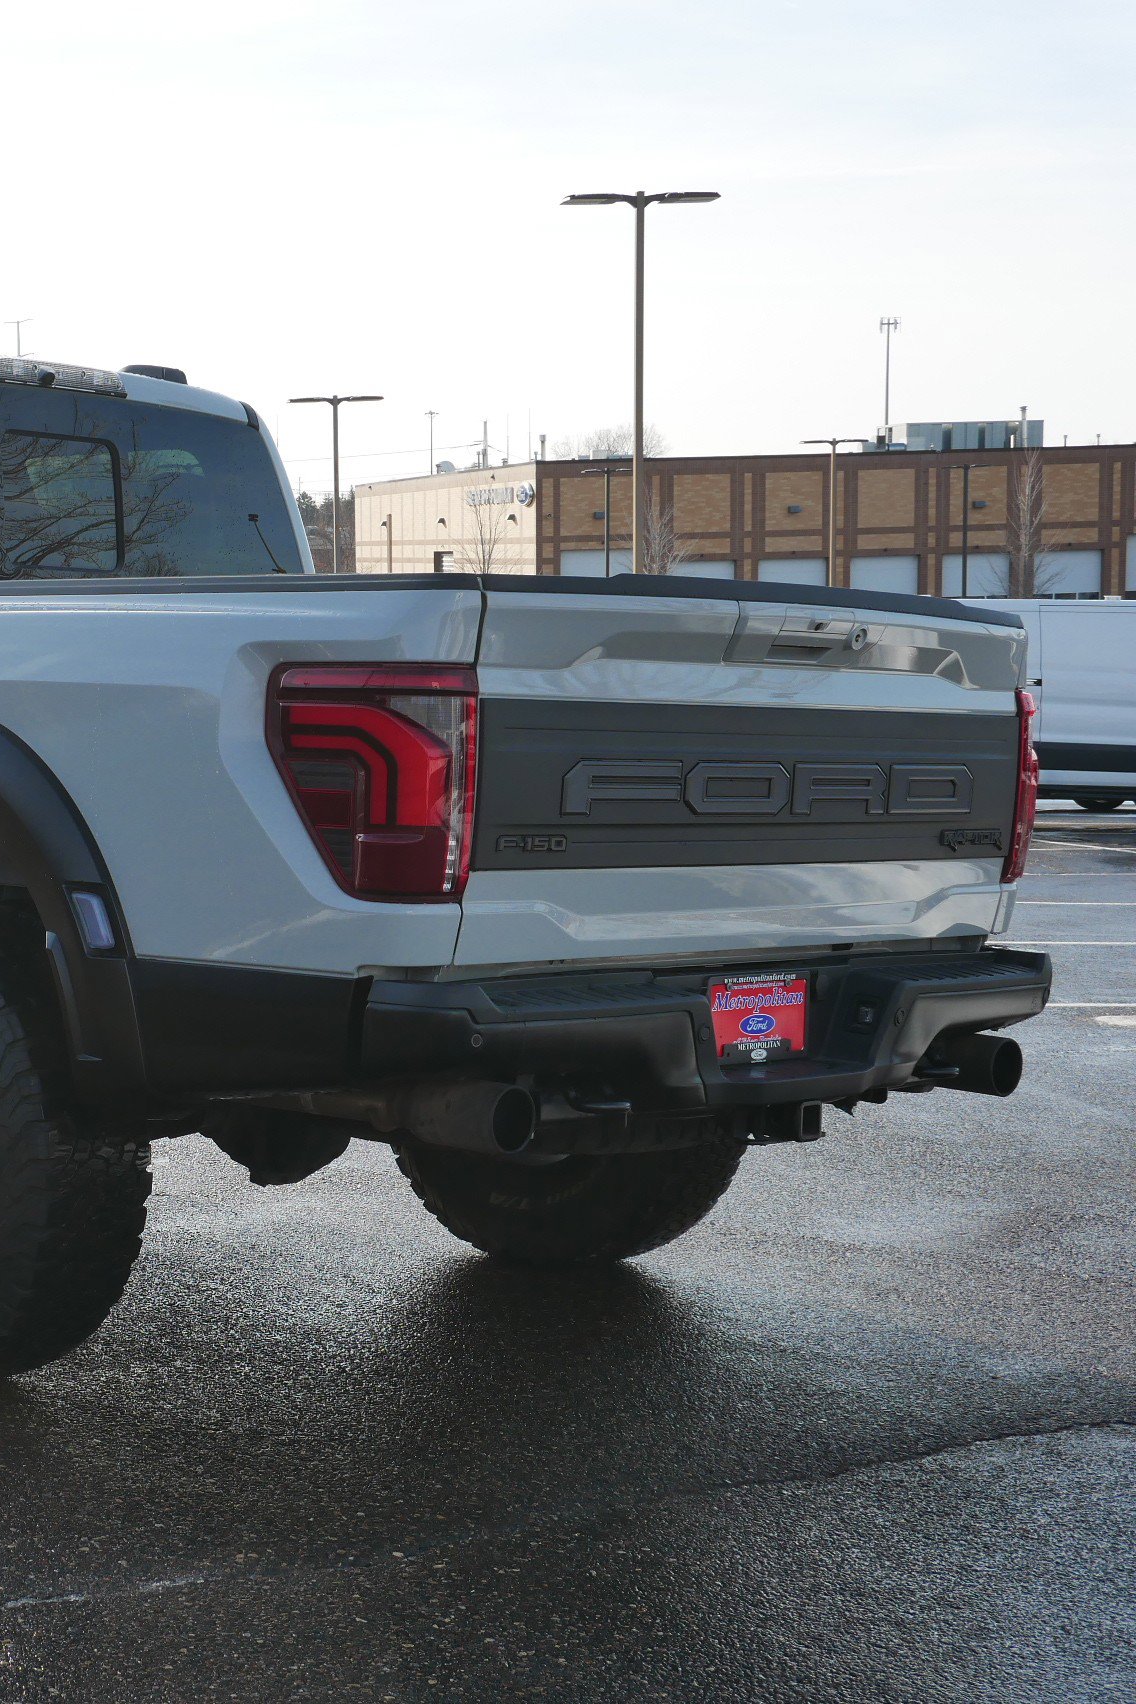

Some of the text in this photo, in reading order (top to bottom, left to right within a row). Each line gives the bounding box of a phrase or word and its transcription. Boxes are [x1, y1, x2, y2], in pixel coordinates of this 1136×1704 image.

[560, 759, 974, 816] FORD
[496, 834, 567, 852] F-150
[712, 987, 804, 1014] Metropolitan
[746, 1017, 768, 1031] Ford
[737, 1040, 781, 1051] METROPOLITAN
